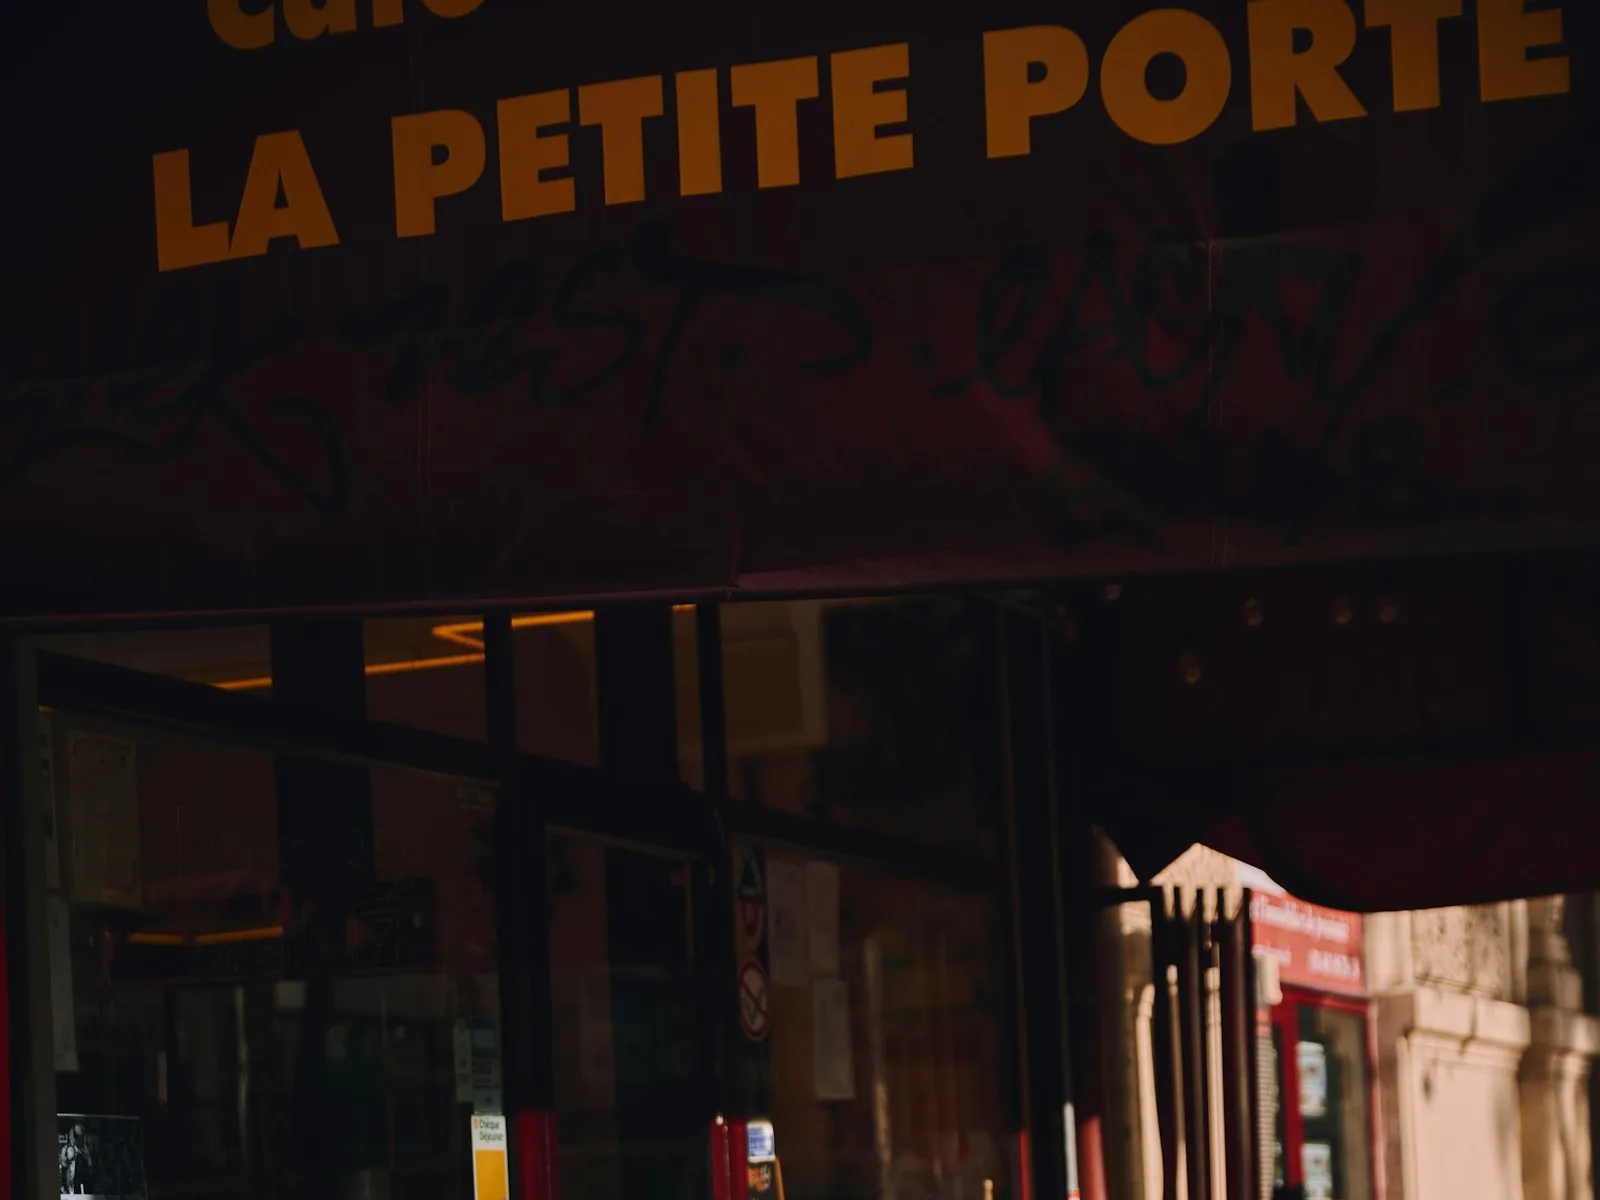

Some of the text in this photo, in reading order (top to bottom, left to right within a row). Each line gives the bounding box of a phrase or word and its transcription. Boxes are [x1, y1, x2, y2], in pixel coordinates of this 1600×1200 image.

[153, 0, 1571, 272] LA PETITE PORTE
